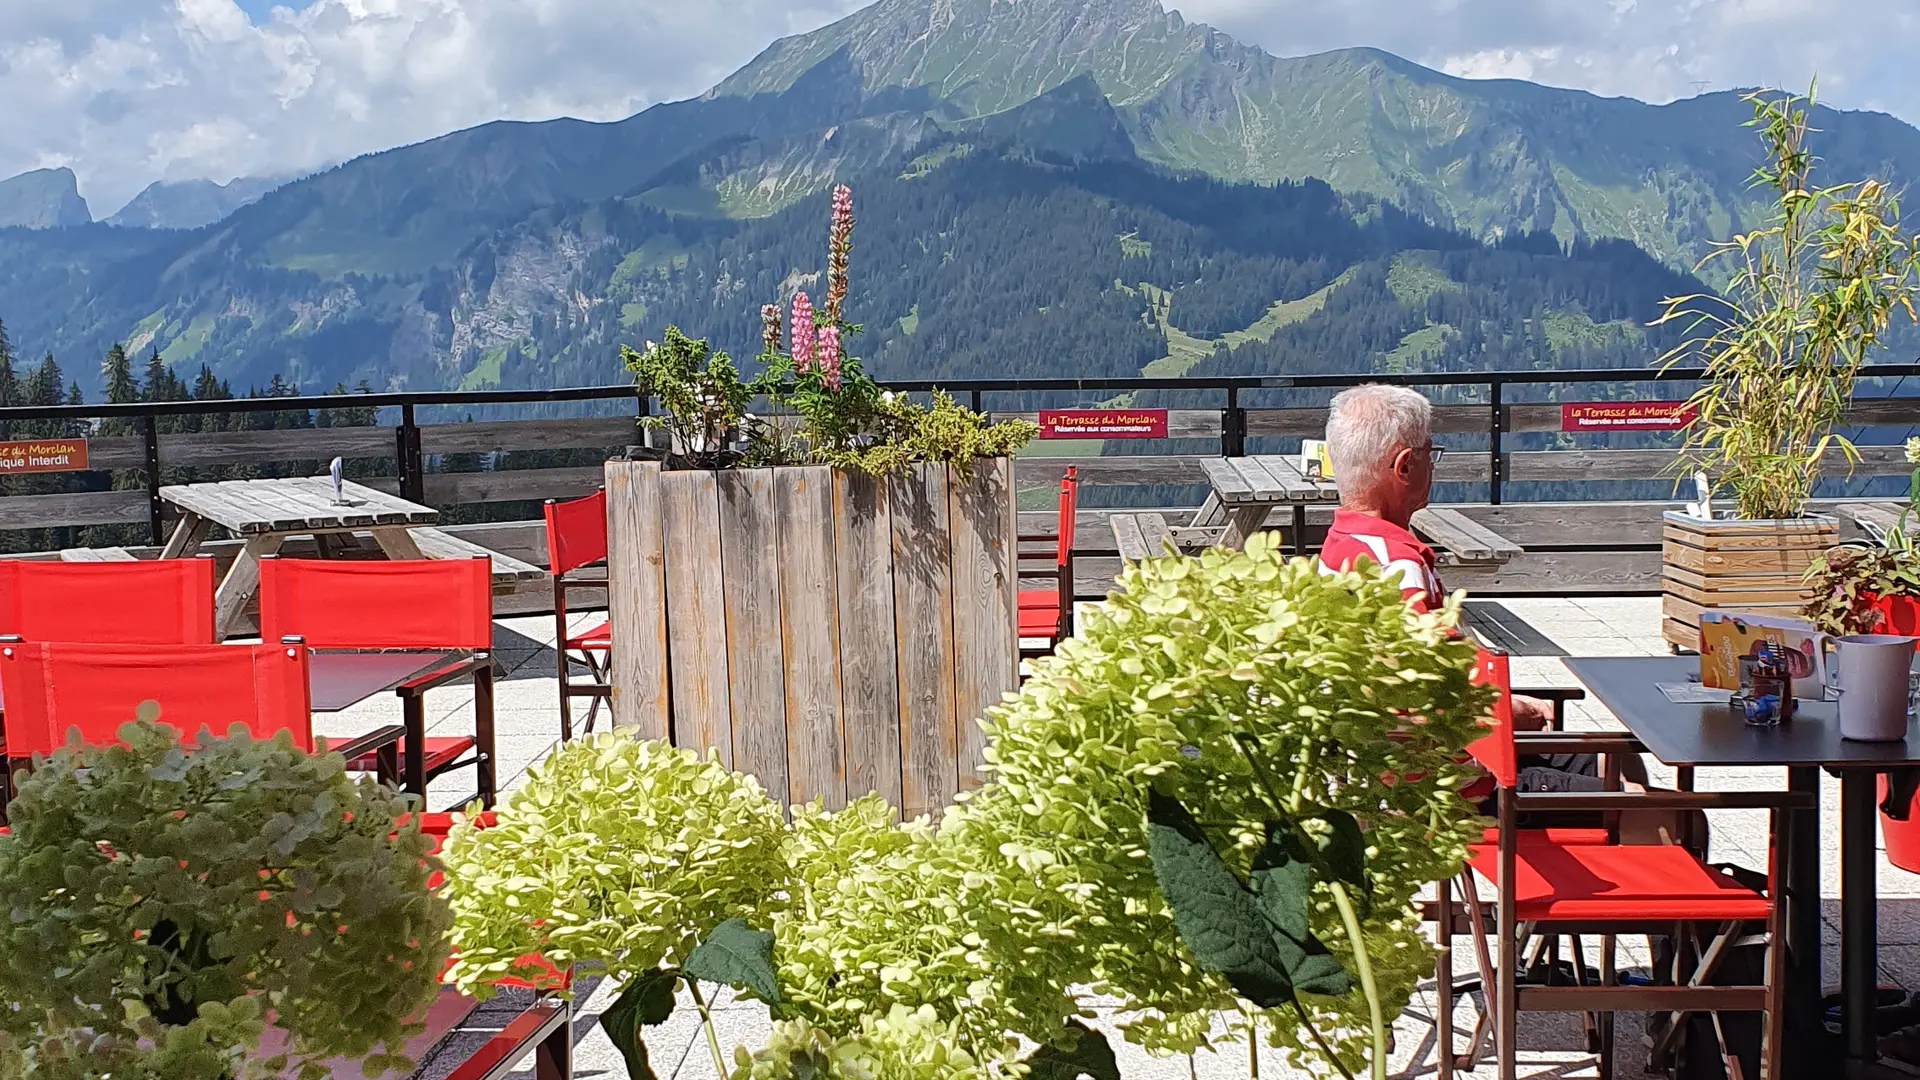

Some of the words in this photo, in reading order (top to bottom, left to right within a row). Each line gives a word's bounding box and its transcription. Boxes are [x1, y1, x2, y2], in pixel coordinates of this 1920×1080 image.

[1583, 407, 1626, 417] Terrasse
[1629, 407, 1642, 416] du
[1644, 406, 1687, 416] Morcla
[1060, 415, 1100, 425] Terrasse
[1101, 415, 1114, 425] du
[1116, 414, 1158, 425] Morclan
[1054, 425, 1086, 433] Réservée
[1100, 425, 1151, 433] consommateurs
[11, 445, 26, 456] du
[29, 443, 77, 455] Morclan
[29, 454, 70, 467] Interdit
